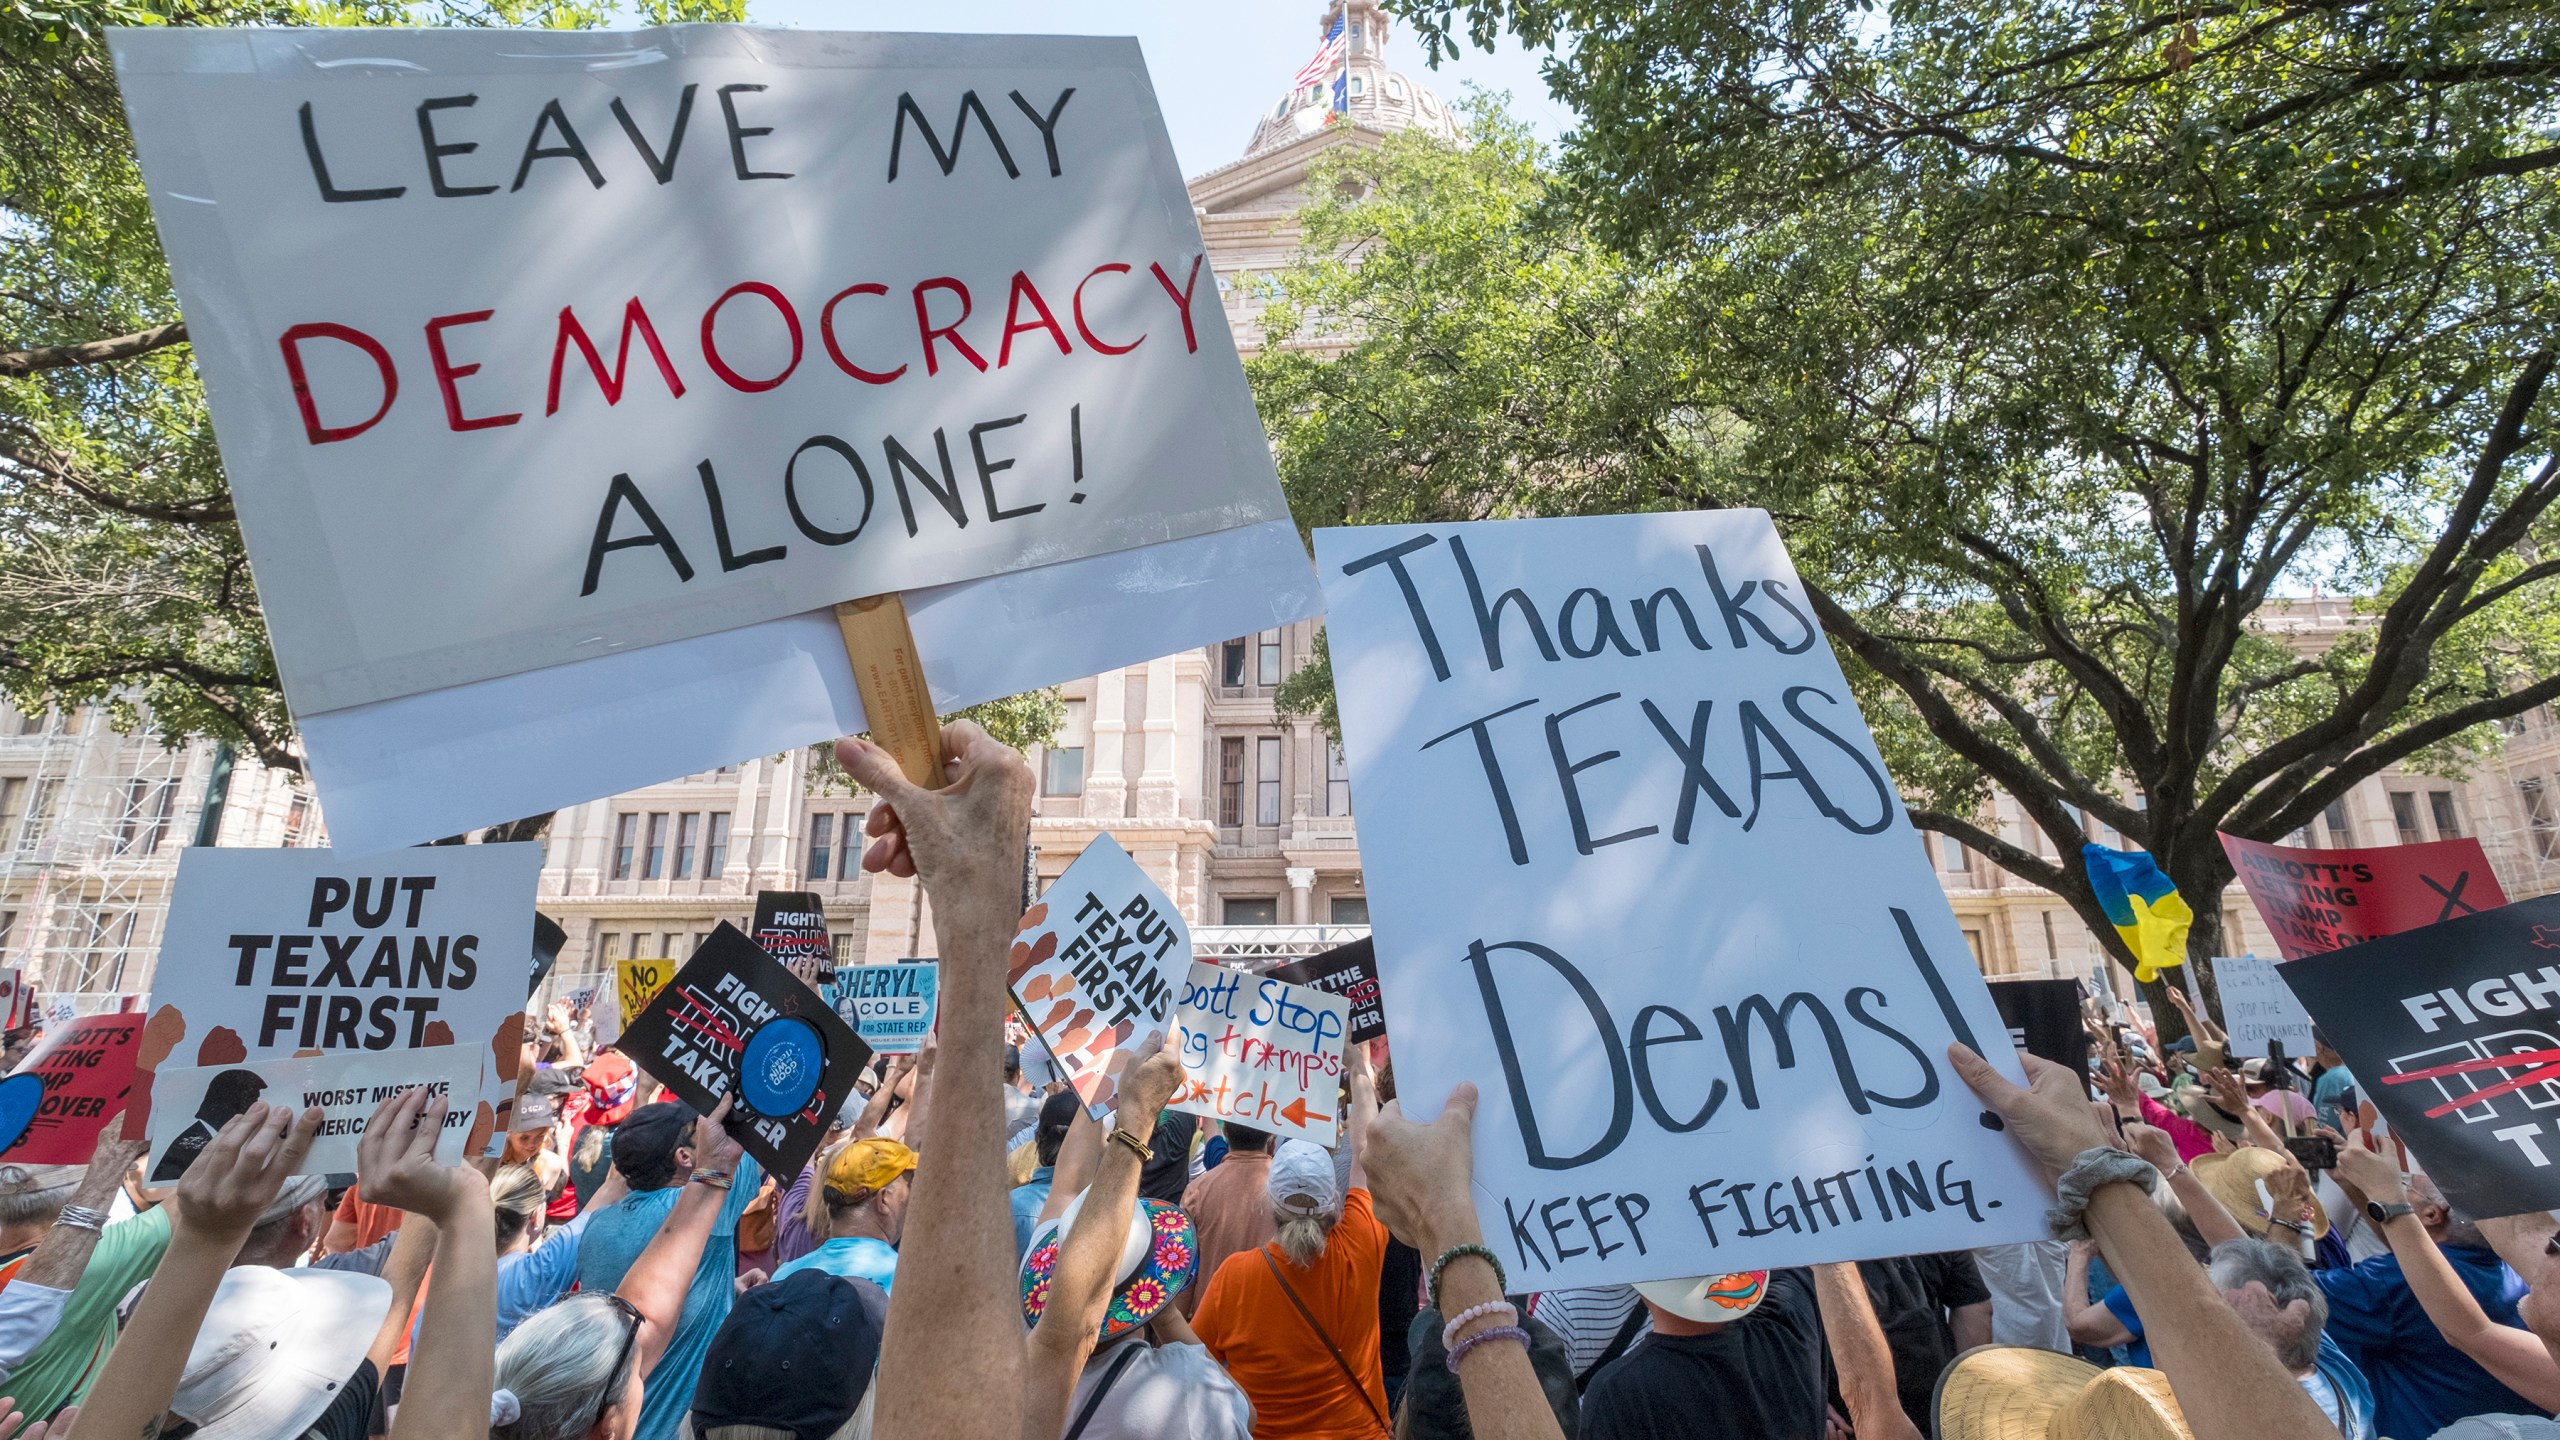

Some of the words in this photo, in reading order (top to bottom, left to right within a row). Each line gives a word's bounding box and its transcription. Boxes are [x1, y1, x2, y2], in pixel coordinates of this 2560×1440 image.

[298, 83, 796, 203] LEAVE
[888, 87, 1077, 183] MY
[279, 253, 1203, 446] DEMOCRACY
[583, 402, 1088, 598] ALONE!
[1341, 532, 1817, 683] Thanks
[899, 664, 912, 694] paint
[907, 692, 927, 746] recycling
[1418, 686, 1894, 866] TEXAS
[2240, 850, 2374, 884] ABBOTT'S
[2247, 870, 2360, 907] LETTING
[307, 876, 437, 929] PUT
[773, 911, 816, 927] FIGHT
[1119, 893, 1179, 962] PUT
[2258, 891, 2343, 929] TRUMP
[227, 934, 480, 991] TEXANS
[630, 965, 658, 988] NO
[832, 968, 921, 1000] SHERYL
[1059, 934, 1142, 1028] FIRST
[1074, 891, 1172, 1023] TEXANS
[1324, 965, 1364, 989] THE
[258, 995, 440, 1051] FIRST
[714, 972, 780, 1025] FIGH
[860, 1001, 920, 1015] COLE
[1249, 979, 1342, 1055] Stop
[2236, 1001, 2257, 1019] STOP
[2261, 1001, 2282, 1015] THE
[2401, 964, 2560, 1034] FIGH
[863, 1024, 875, 1033] FOR
[877, 1022, 905, 1034] STATE
[907, 1021, 927, 1033] REP
[303, 1088, 367, 1109] WORST
[773, 1060, 797, 1086] GOOD
[1504, 1191, 1650, 1273] KEEP
